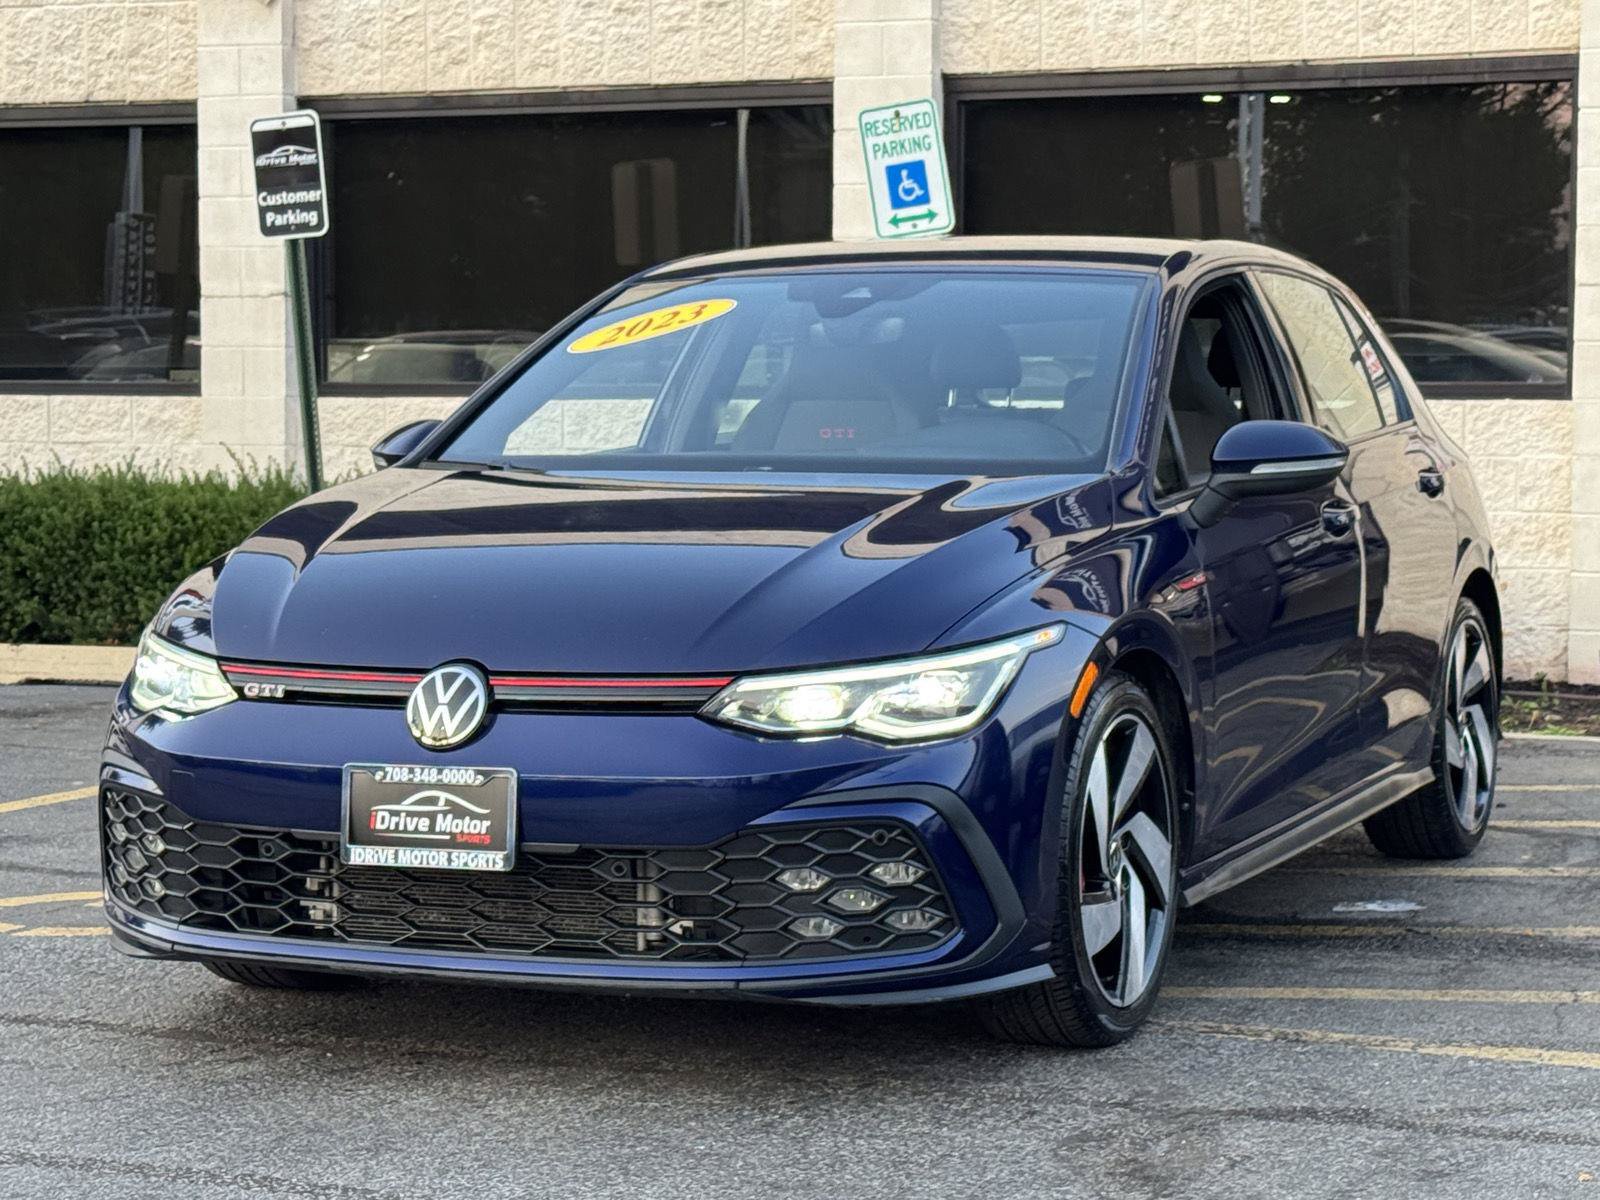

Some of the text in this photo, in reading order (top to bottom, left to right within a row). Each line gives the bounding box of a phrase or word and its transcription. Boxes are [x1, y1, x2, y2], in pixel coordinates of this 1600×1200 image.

[864, 111, 932, 138] RESERVED
[872, 134, 932, 160] PARKING
[259, 190, 322, 207] Customer
[265, 209, 319, 227] Parking
[597, 303, 708, 347] 2023
[244, 682, 286, 699] GTI
[384, 766, 475, 785] 708-348-0000
[369, 810, 491, 834] iDrive Motor
[455, 834, 492, 845] SPORTS
[399, 851, 449, 868] MOTOR
[451, 852, 504, 869] SPORTS
